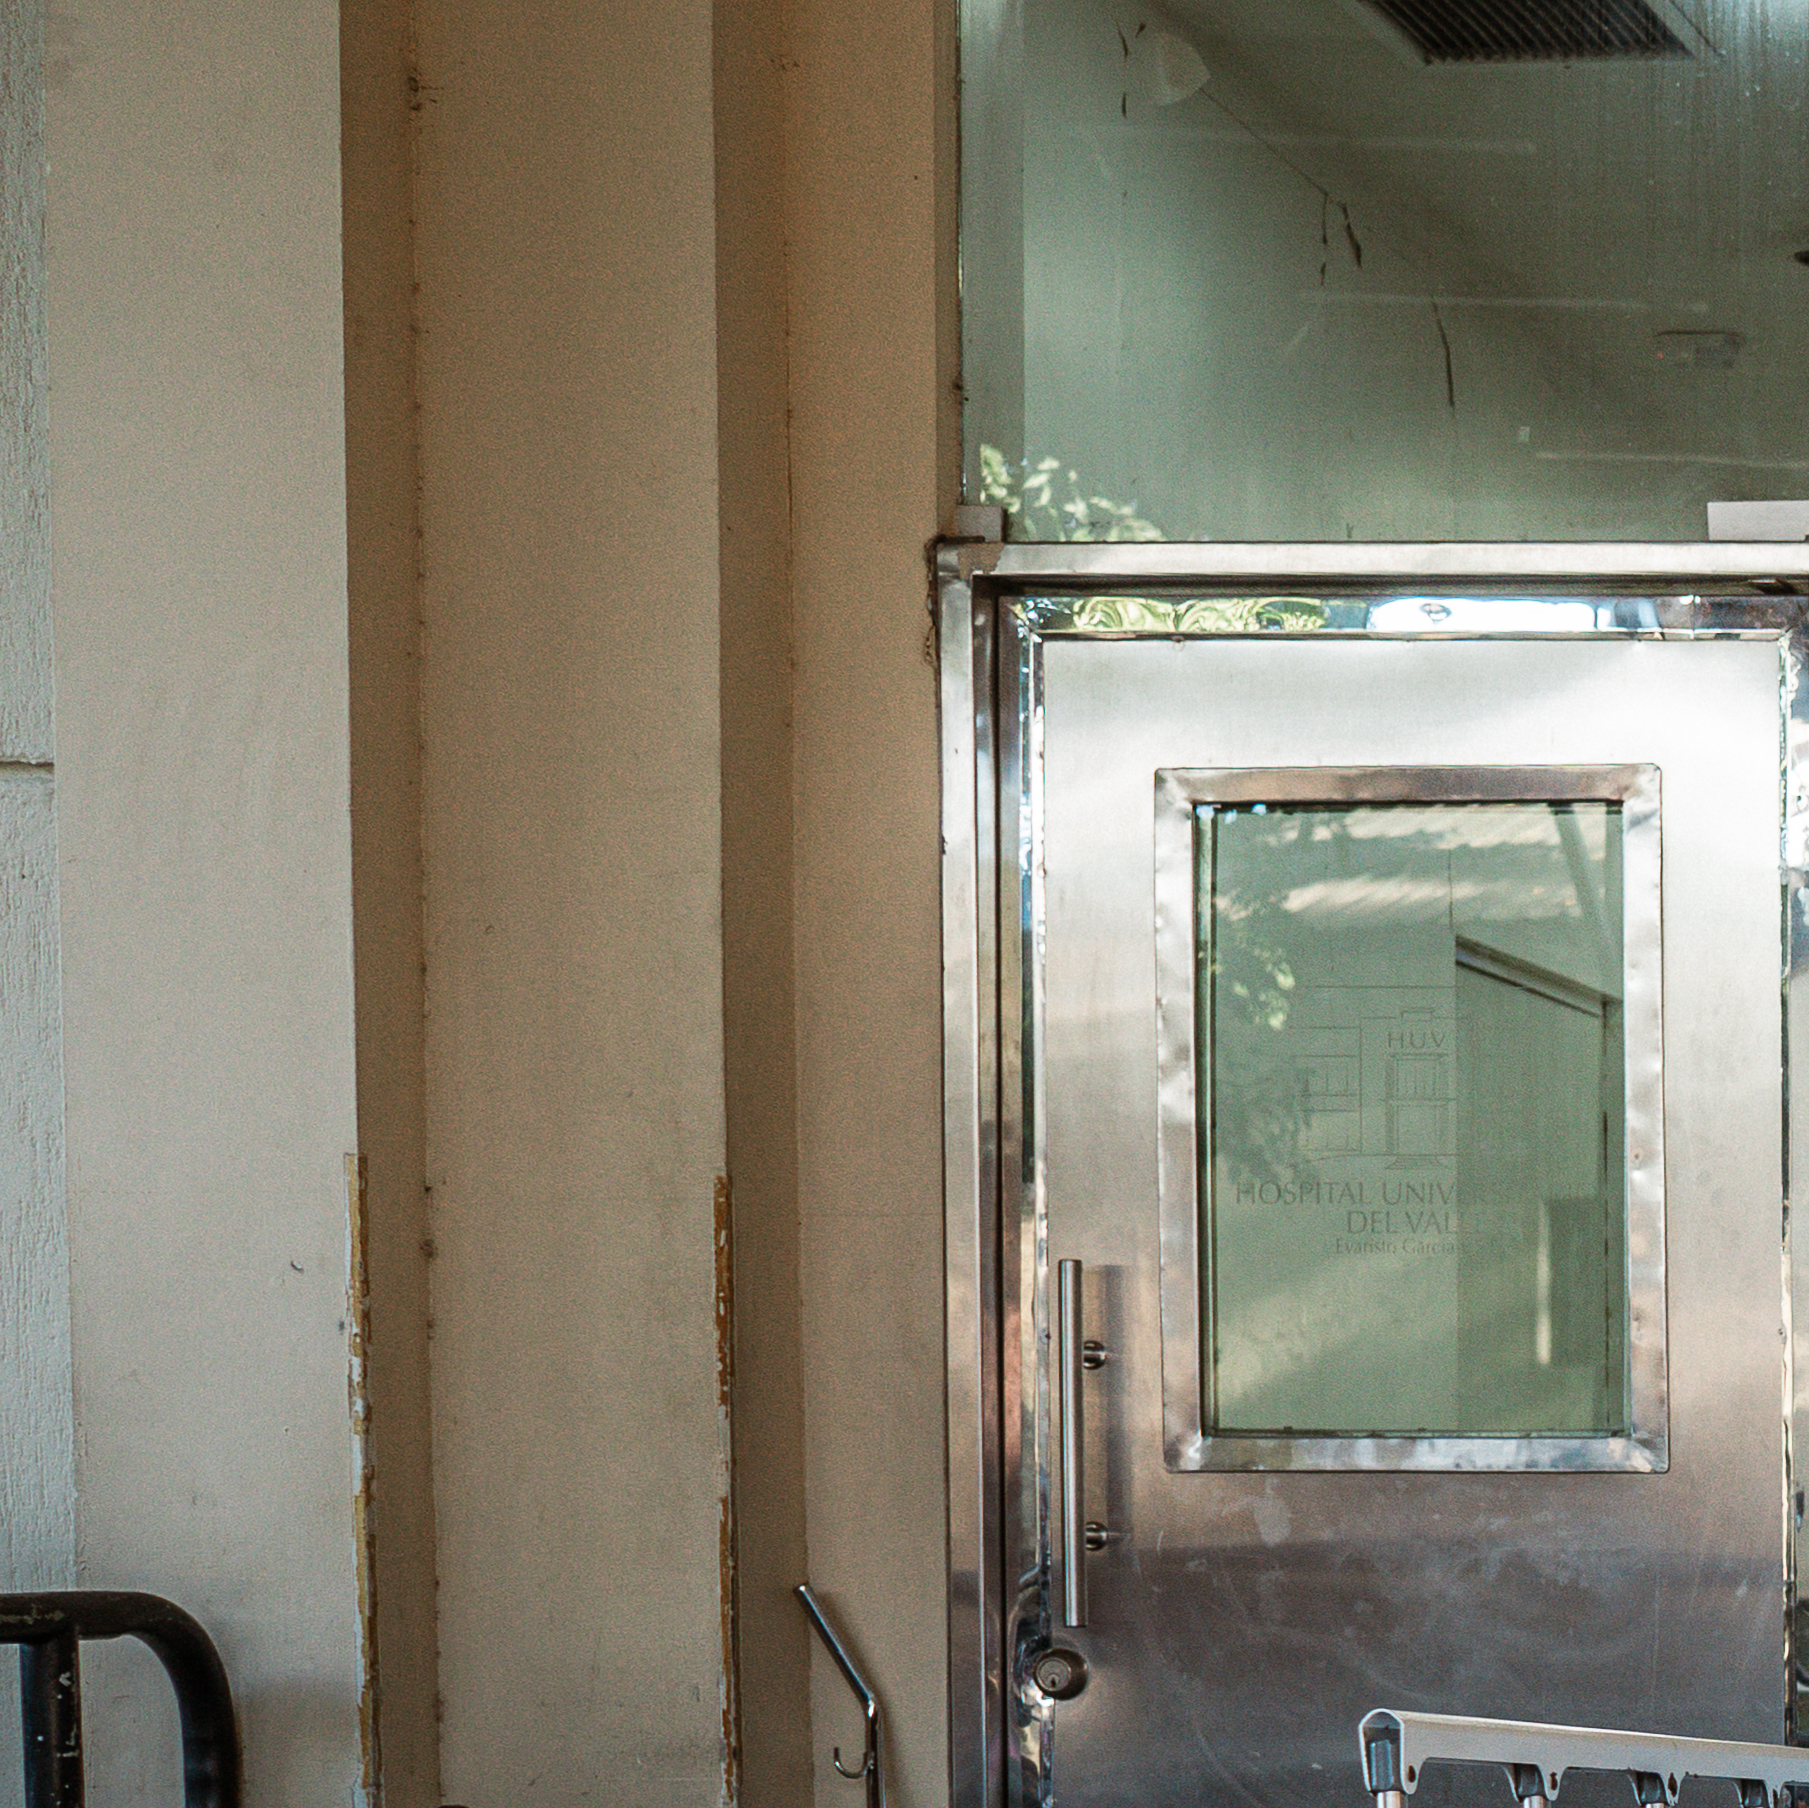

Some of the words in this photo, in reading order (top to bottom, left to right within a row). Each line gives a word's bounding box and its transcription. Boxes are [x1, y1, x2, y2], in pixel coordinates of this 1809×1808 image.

[1386, 1030, 1446, 1049] HUV
[1235, 1181, 1373, 1205] HOSPITAL
[1346, 1211, 1398, 1235] DEL
